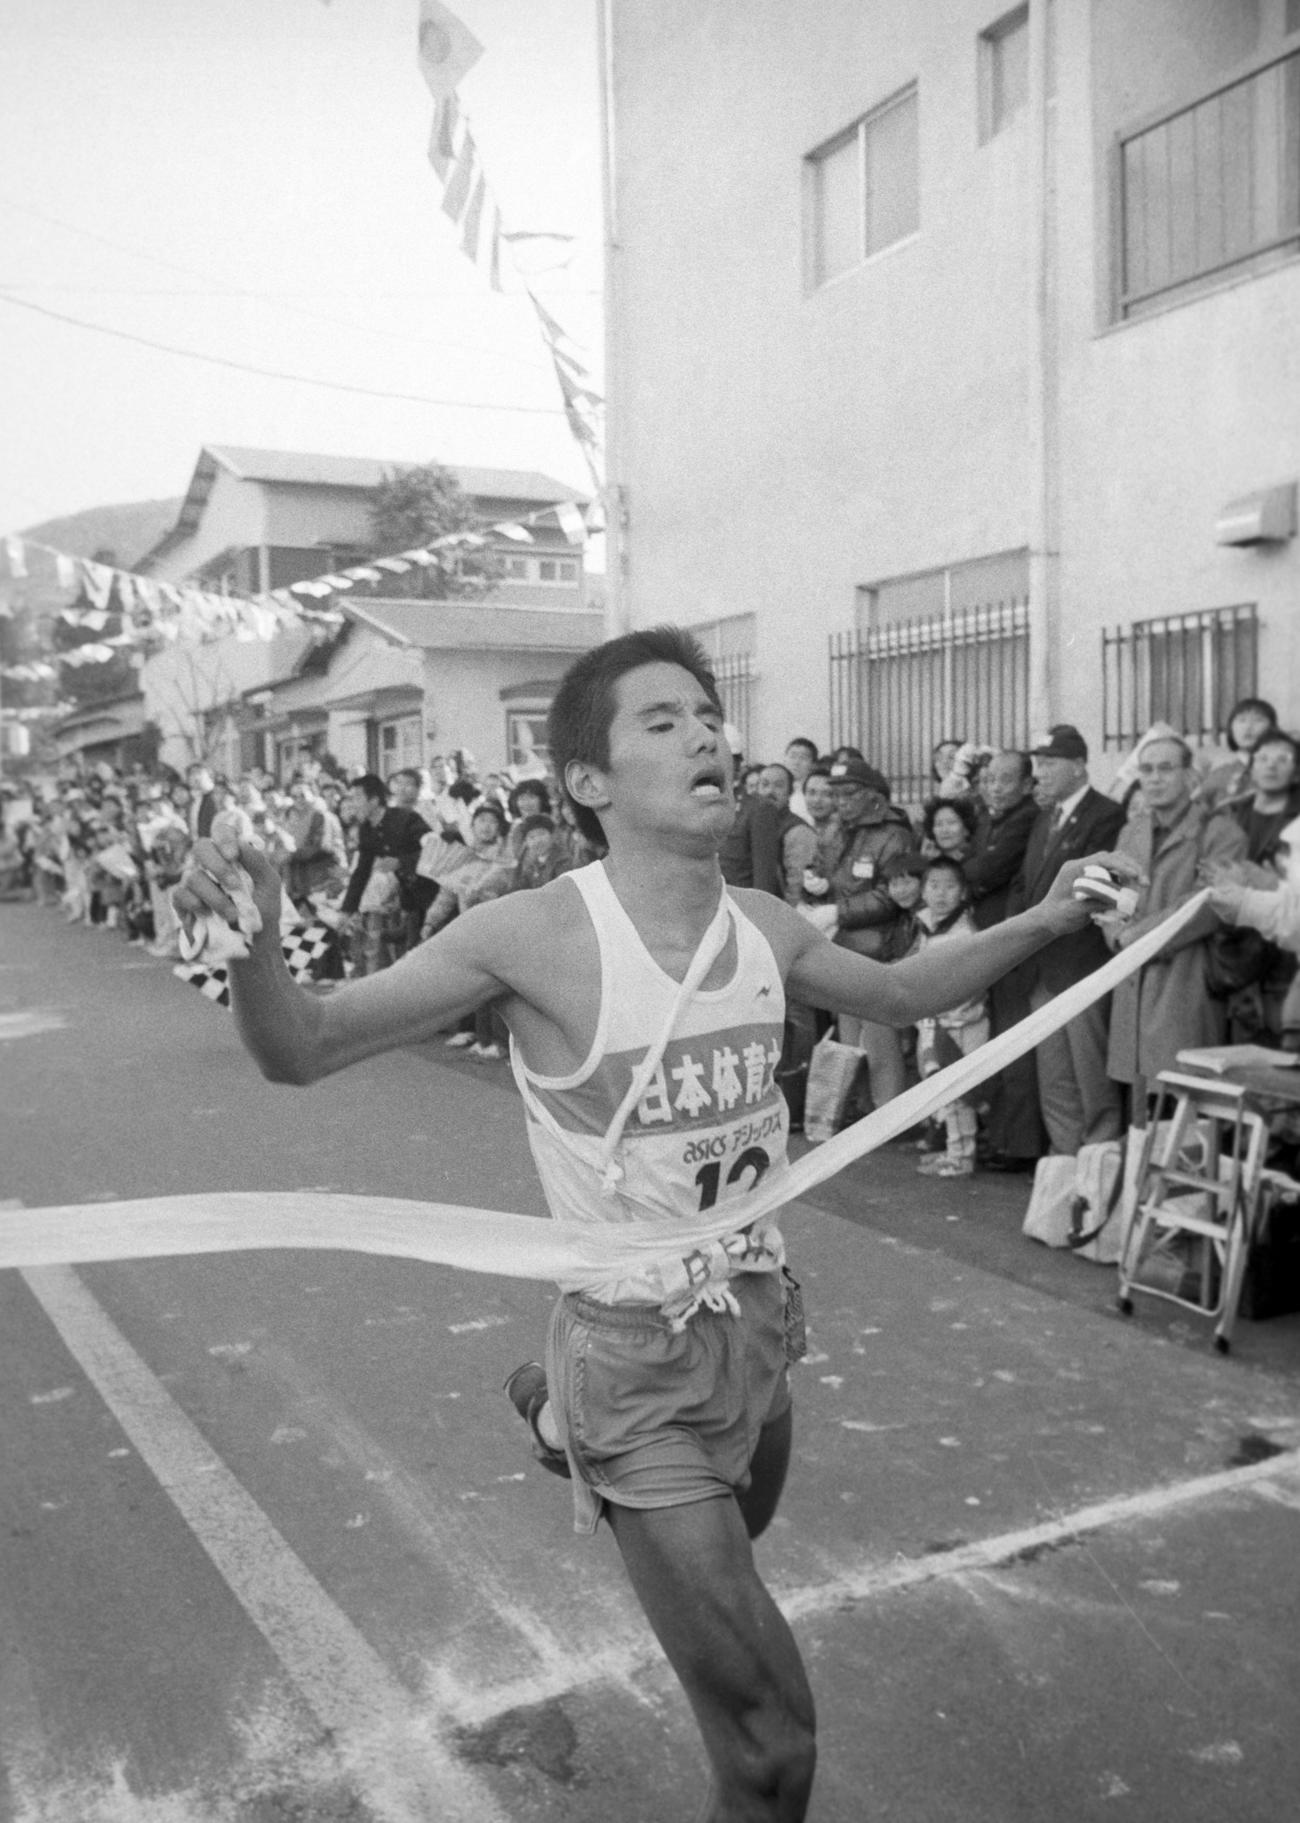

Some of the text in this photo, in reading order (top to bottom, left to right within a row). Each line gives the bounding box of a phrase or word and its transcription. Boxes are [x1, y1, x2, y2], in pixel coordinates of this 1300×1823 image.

[731, 1112, 782, 1152] アシックス
